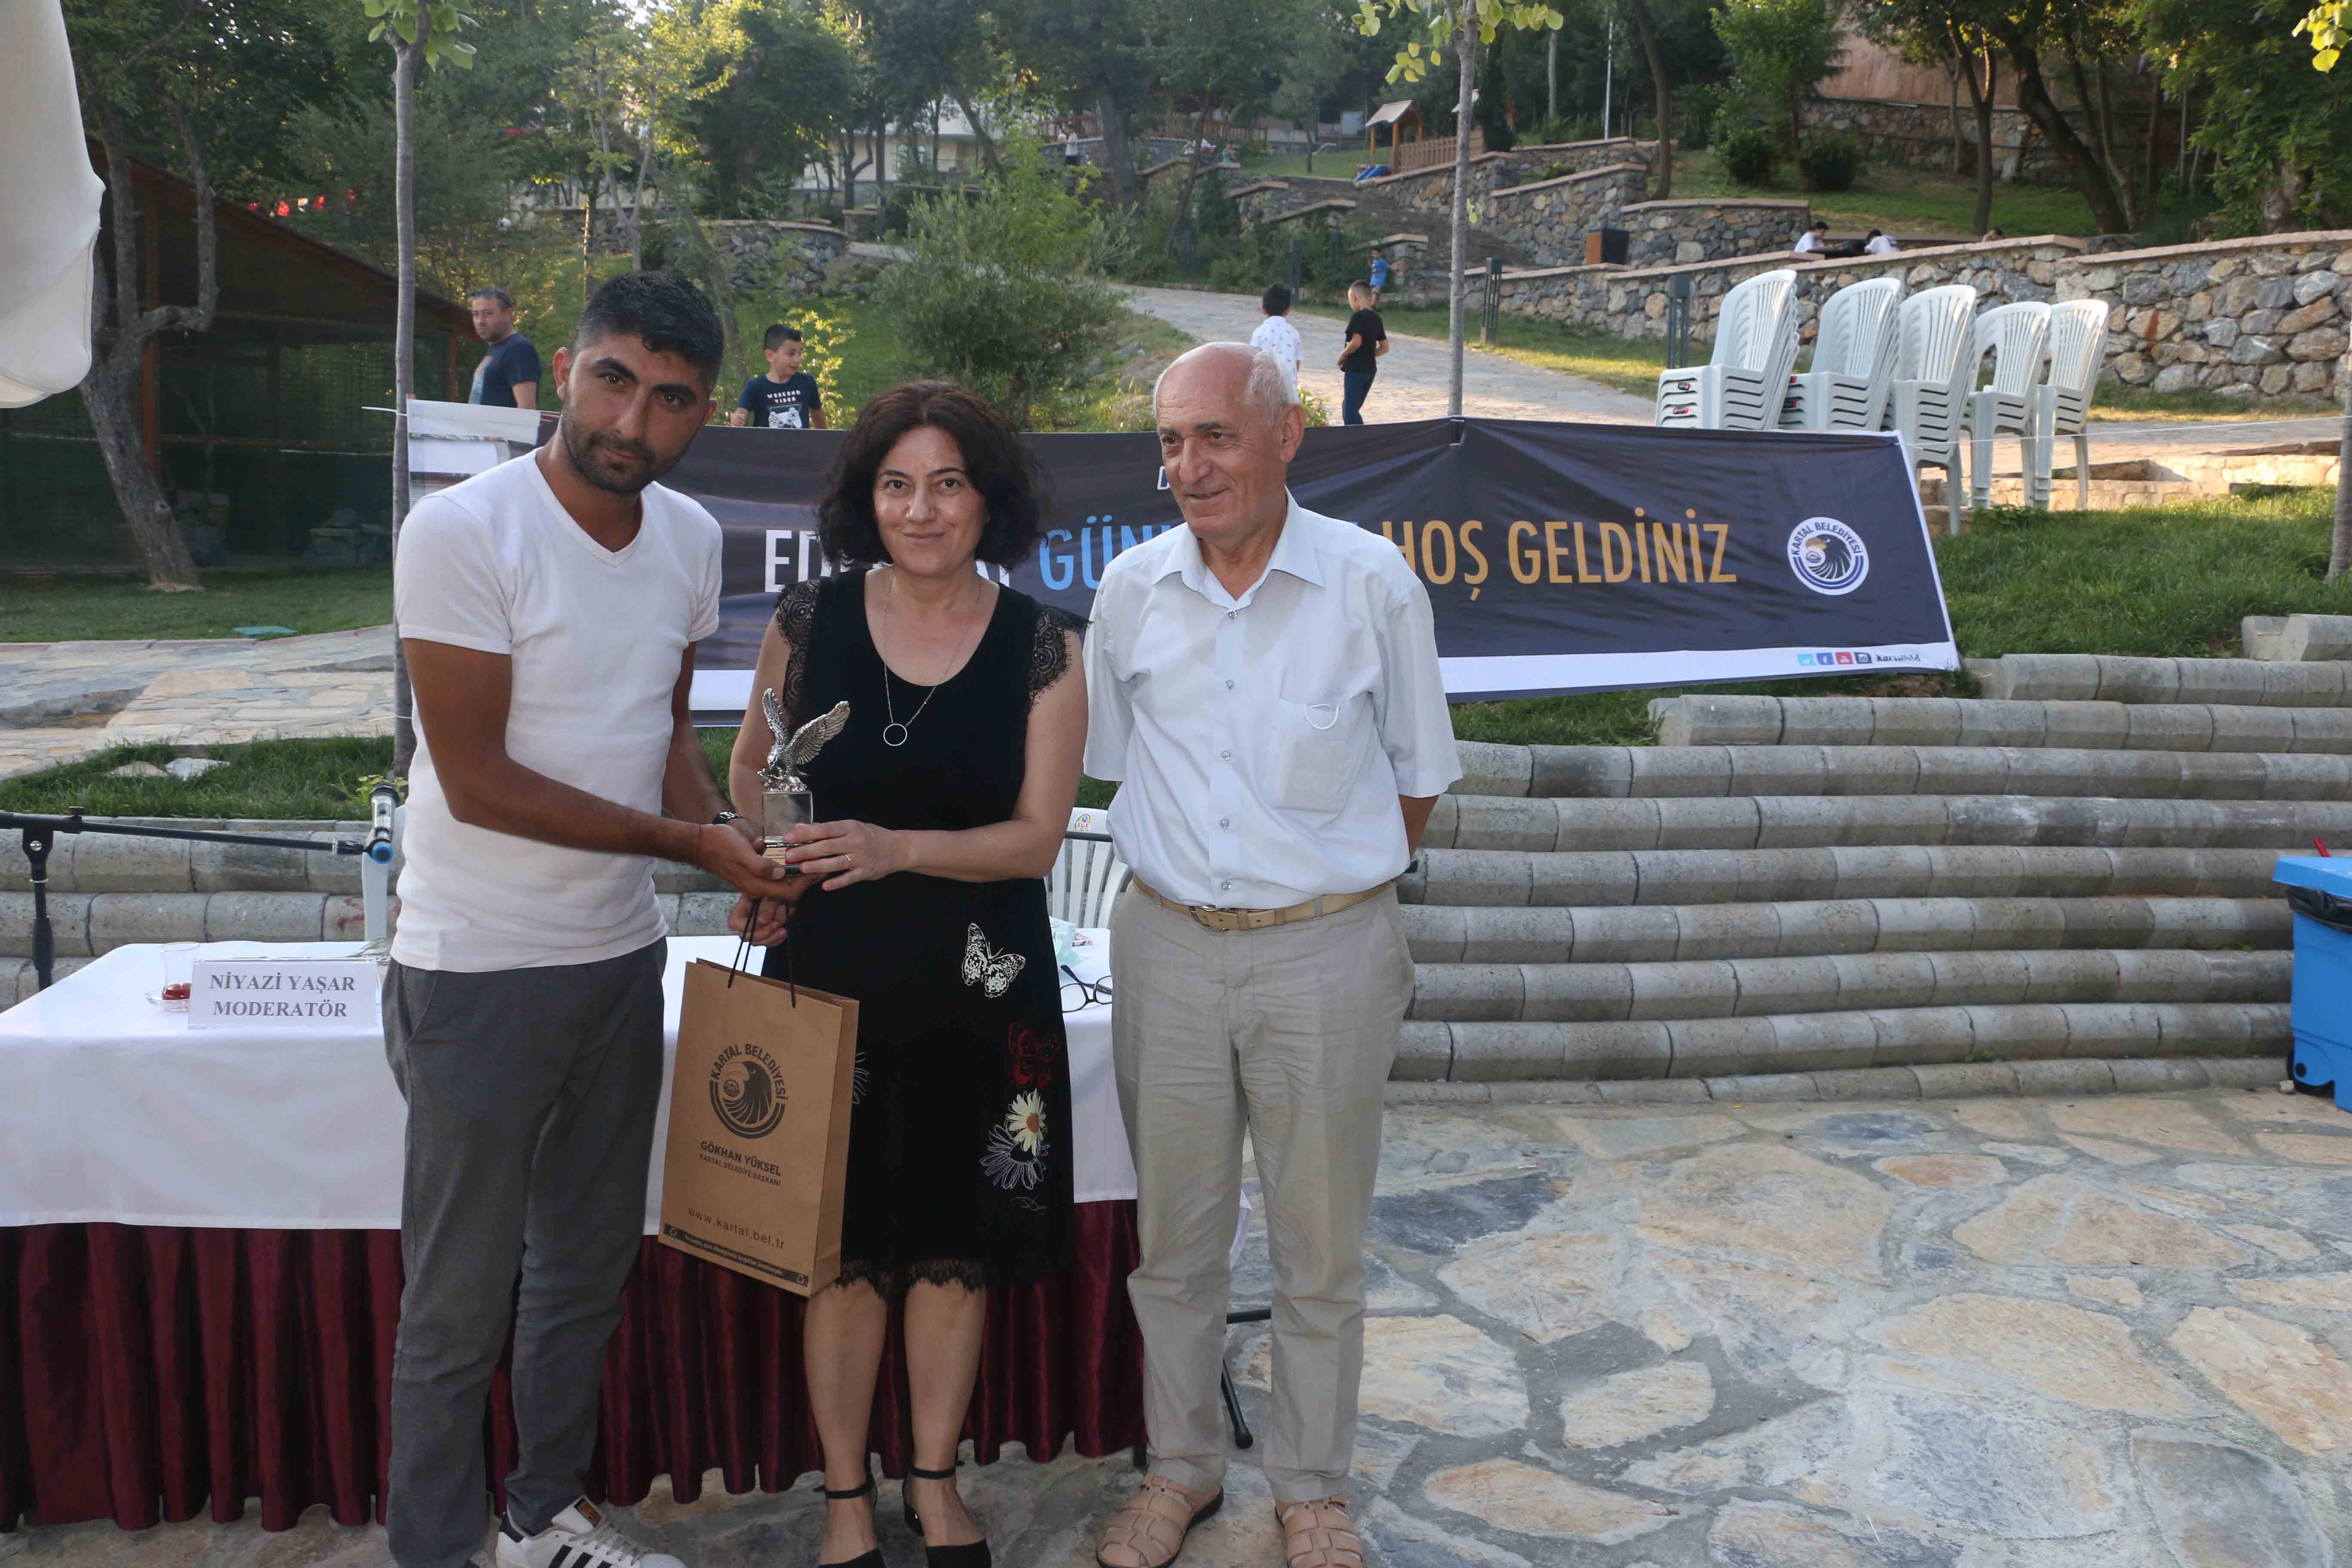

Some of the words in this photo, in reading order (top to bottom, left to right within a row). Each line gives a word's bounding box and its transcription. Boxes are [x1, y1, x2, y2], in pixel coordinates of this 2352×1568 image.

[767, 390, 801, 398] WEEKEND
[1382, 520, 1488, 601] HOŞ
[1508, 507, 1737, 584] GELDİNİZ
[1792, 525, 1815, 556] KARTAL
[1815, 522, 1864, 554] BELEDİYESİ
[209, 971, 282, 989] NİYAZİ
[287, 976, 355, 994] YAŞAR
[213, 998, 348, 1017] MODERATÖR
[710, 1044, 742, 1080] KARTAL
[745, 1043, 789, 1100] BELEDİYESİ
[701, 1141, 742, 1163] GÖKHAN
[744, 1155, 781, 1176] YÜKSEL
[687, 1208, 784, 1249] www.kartal.bel.tr
